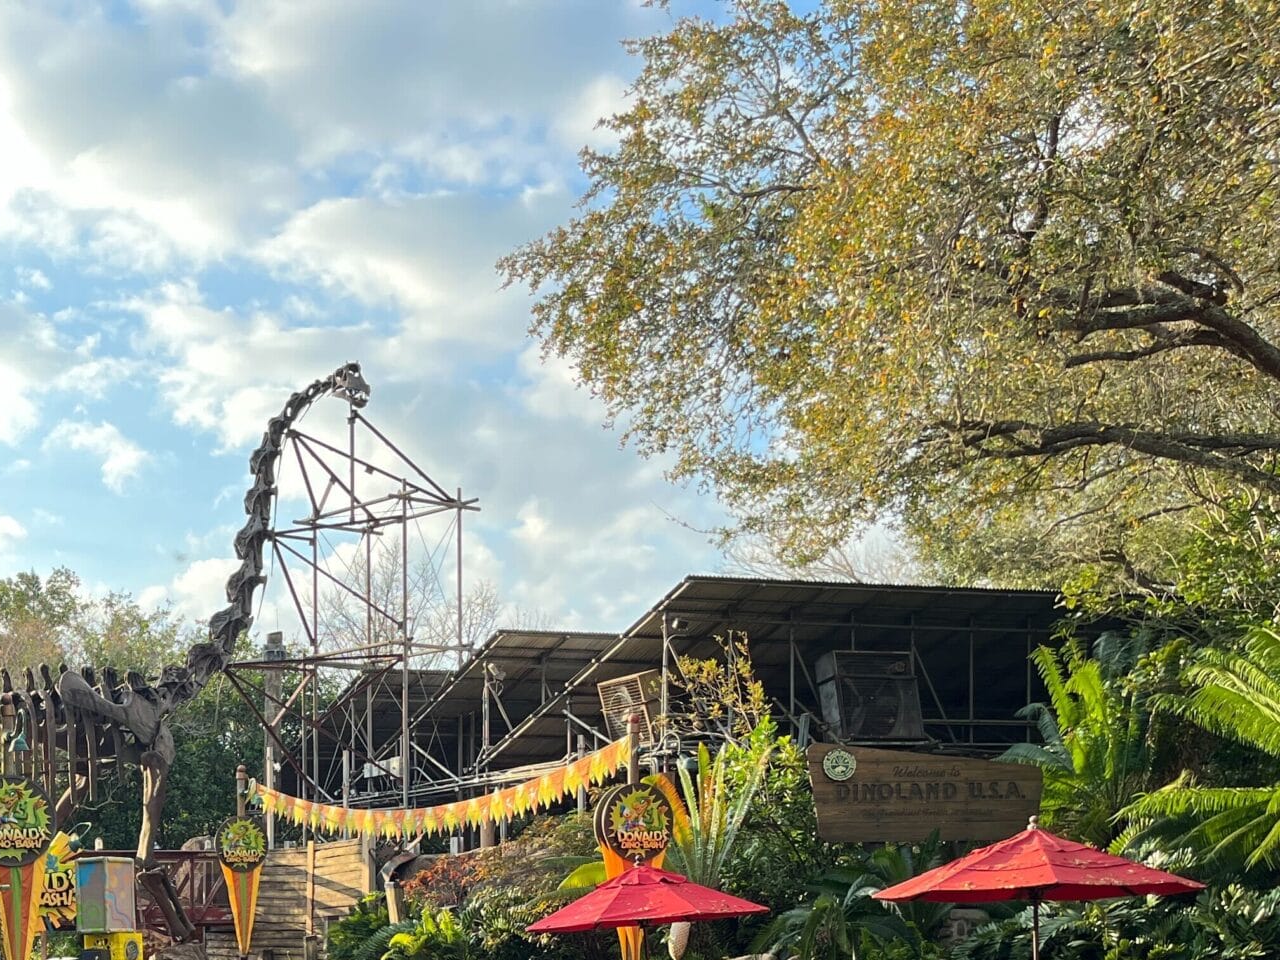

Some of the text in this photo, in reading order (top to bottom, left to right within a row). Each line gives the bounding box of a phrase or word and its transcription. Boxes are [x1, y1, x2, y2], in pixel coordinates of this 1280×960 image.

[835, 781, 1026, 801] DINOLAND U.S.A.
[617, 829, 669, 842] DONALD'S
